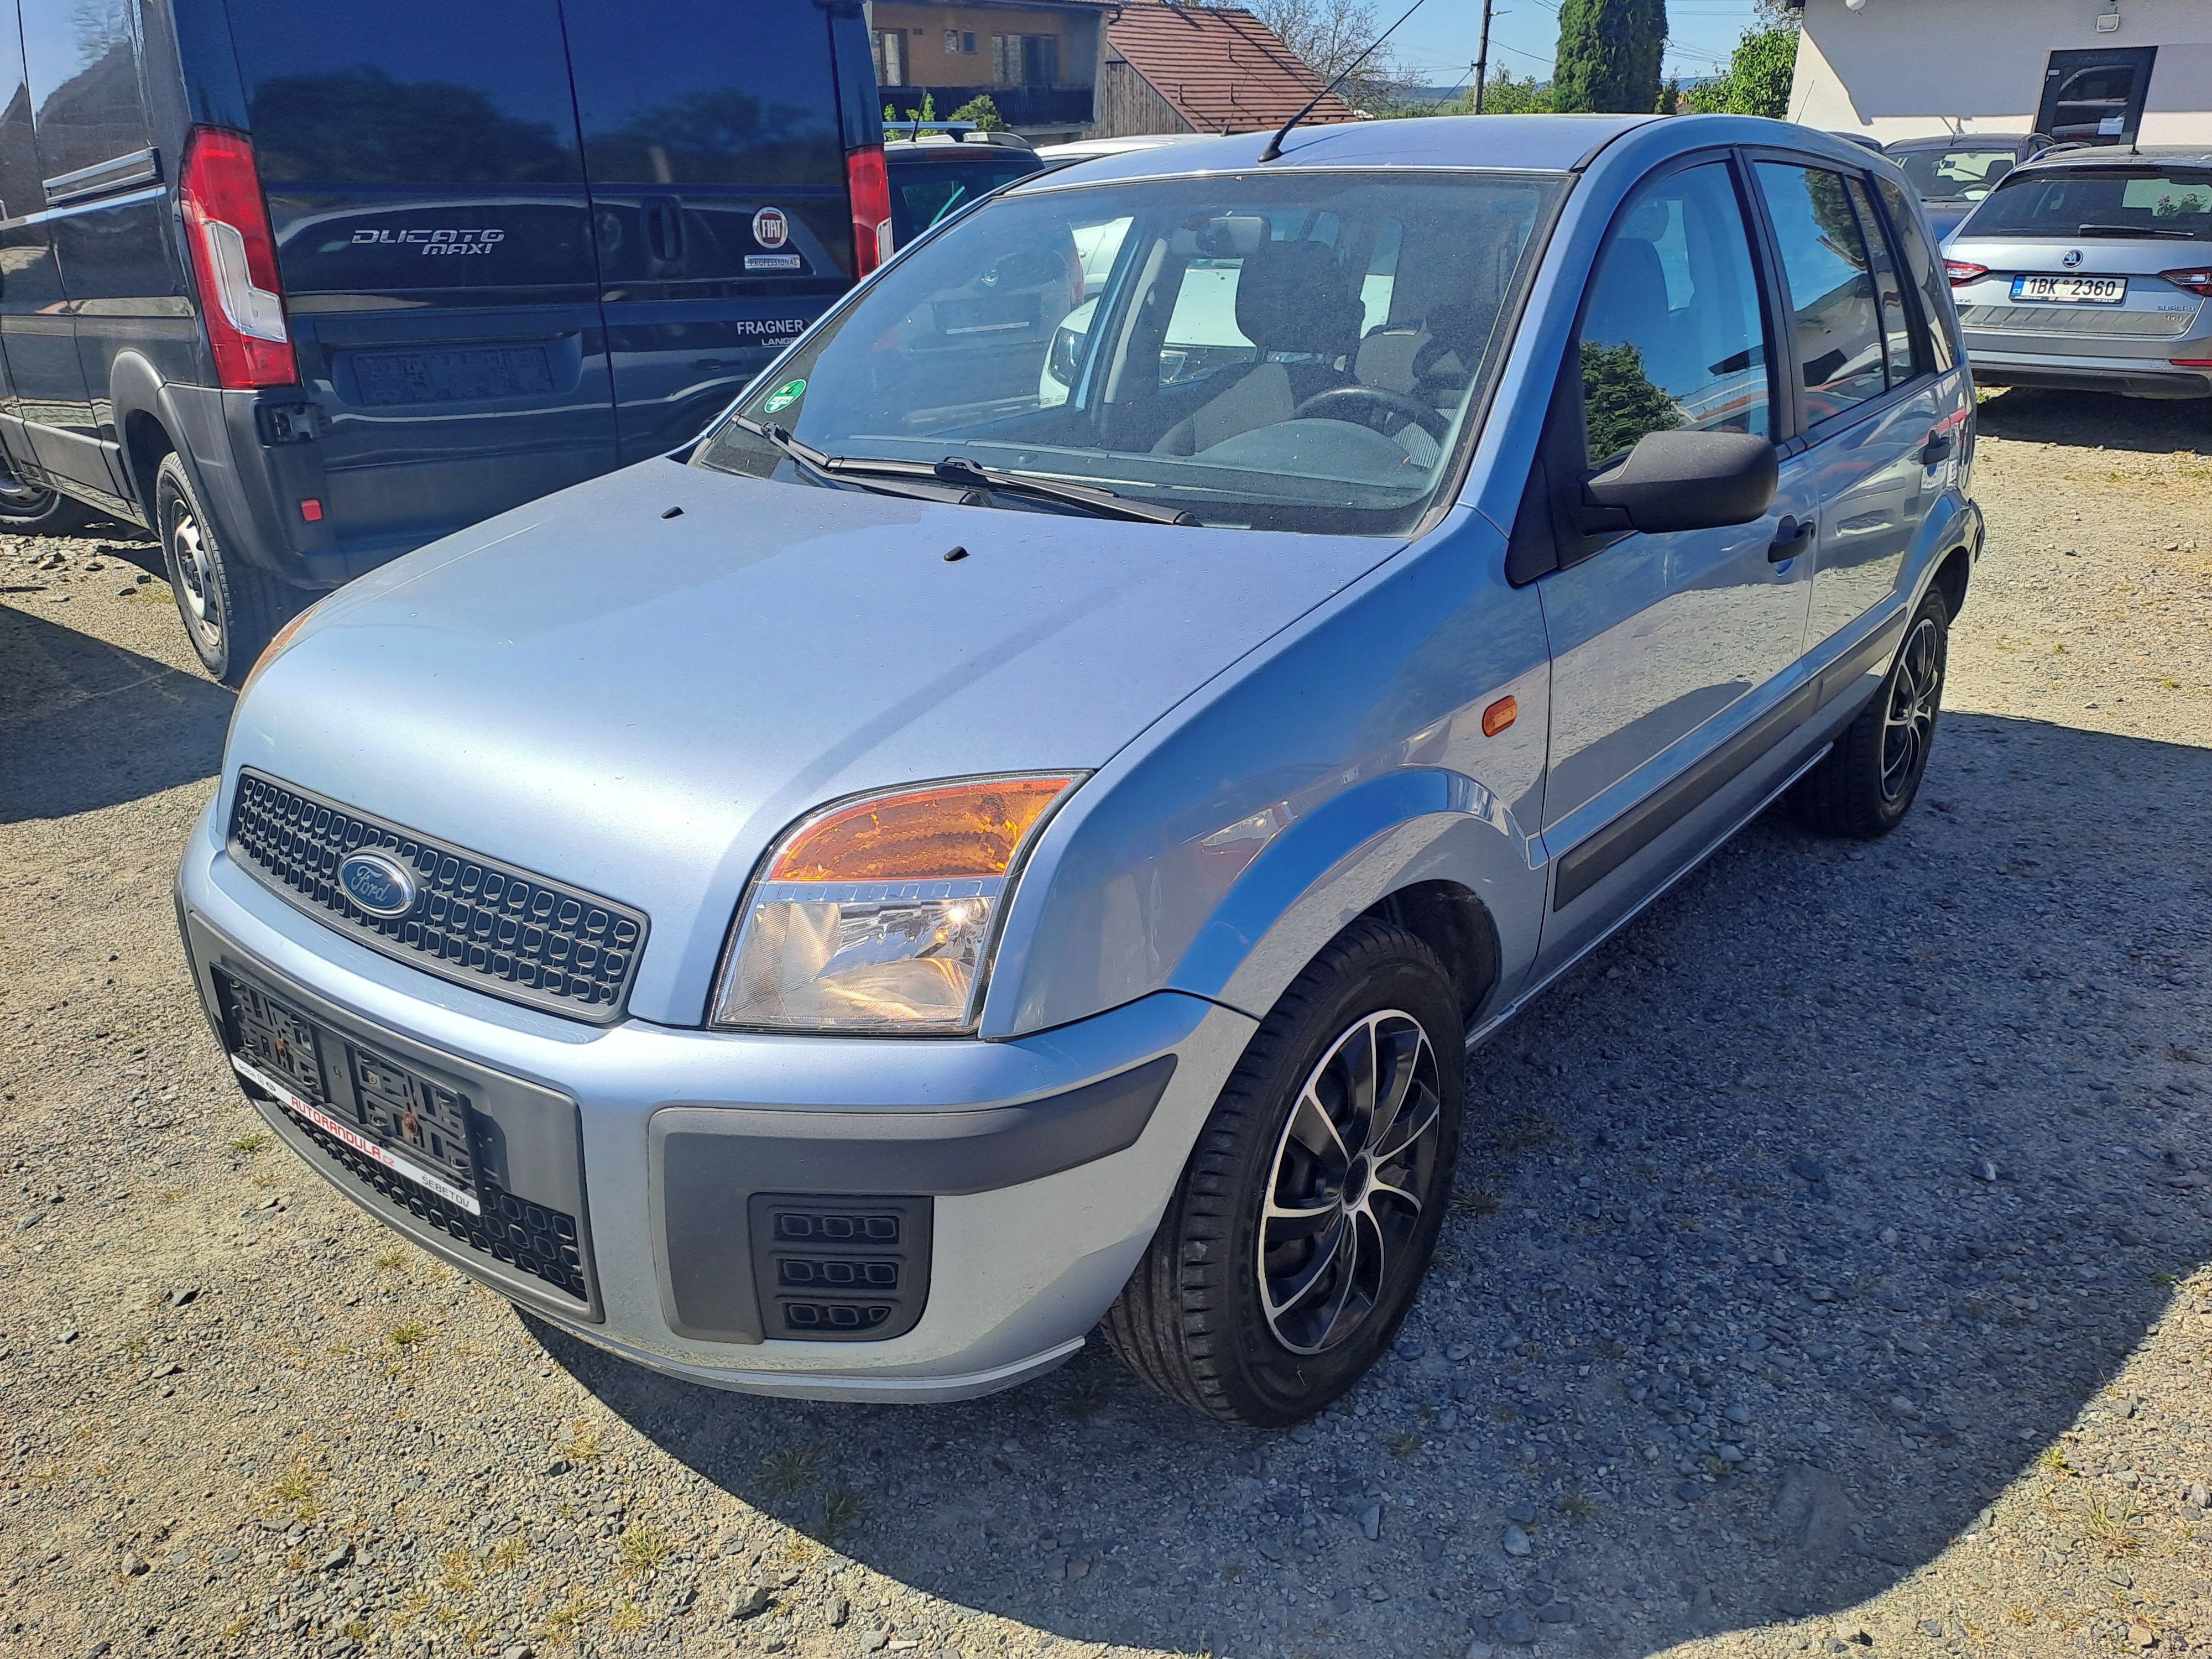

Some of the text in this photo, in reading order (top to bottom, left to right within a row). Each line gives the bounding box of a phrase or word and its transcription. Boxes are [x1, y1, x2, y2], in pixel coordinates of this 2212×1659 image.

[352, 229, 505, 243] DUCATO
[761, 219, 781, 238] FIAT
[422, 243, 493, 255] MAXI
[750, 258, 797, 267] PROFESSIONAL
[2030, 278, 2116, 297] 1BK 2360
[737, 319, 804, 335] FRAGNER
[350, 865, 391, 902] Ford
[422, 1174, 469, 1208] ŠEBETOV
